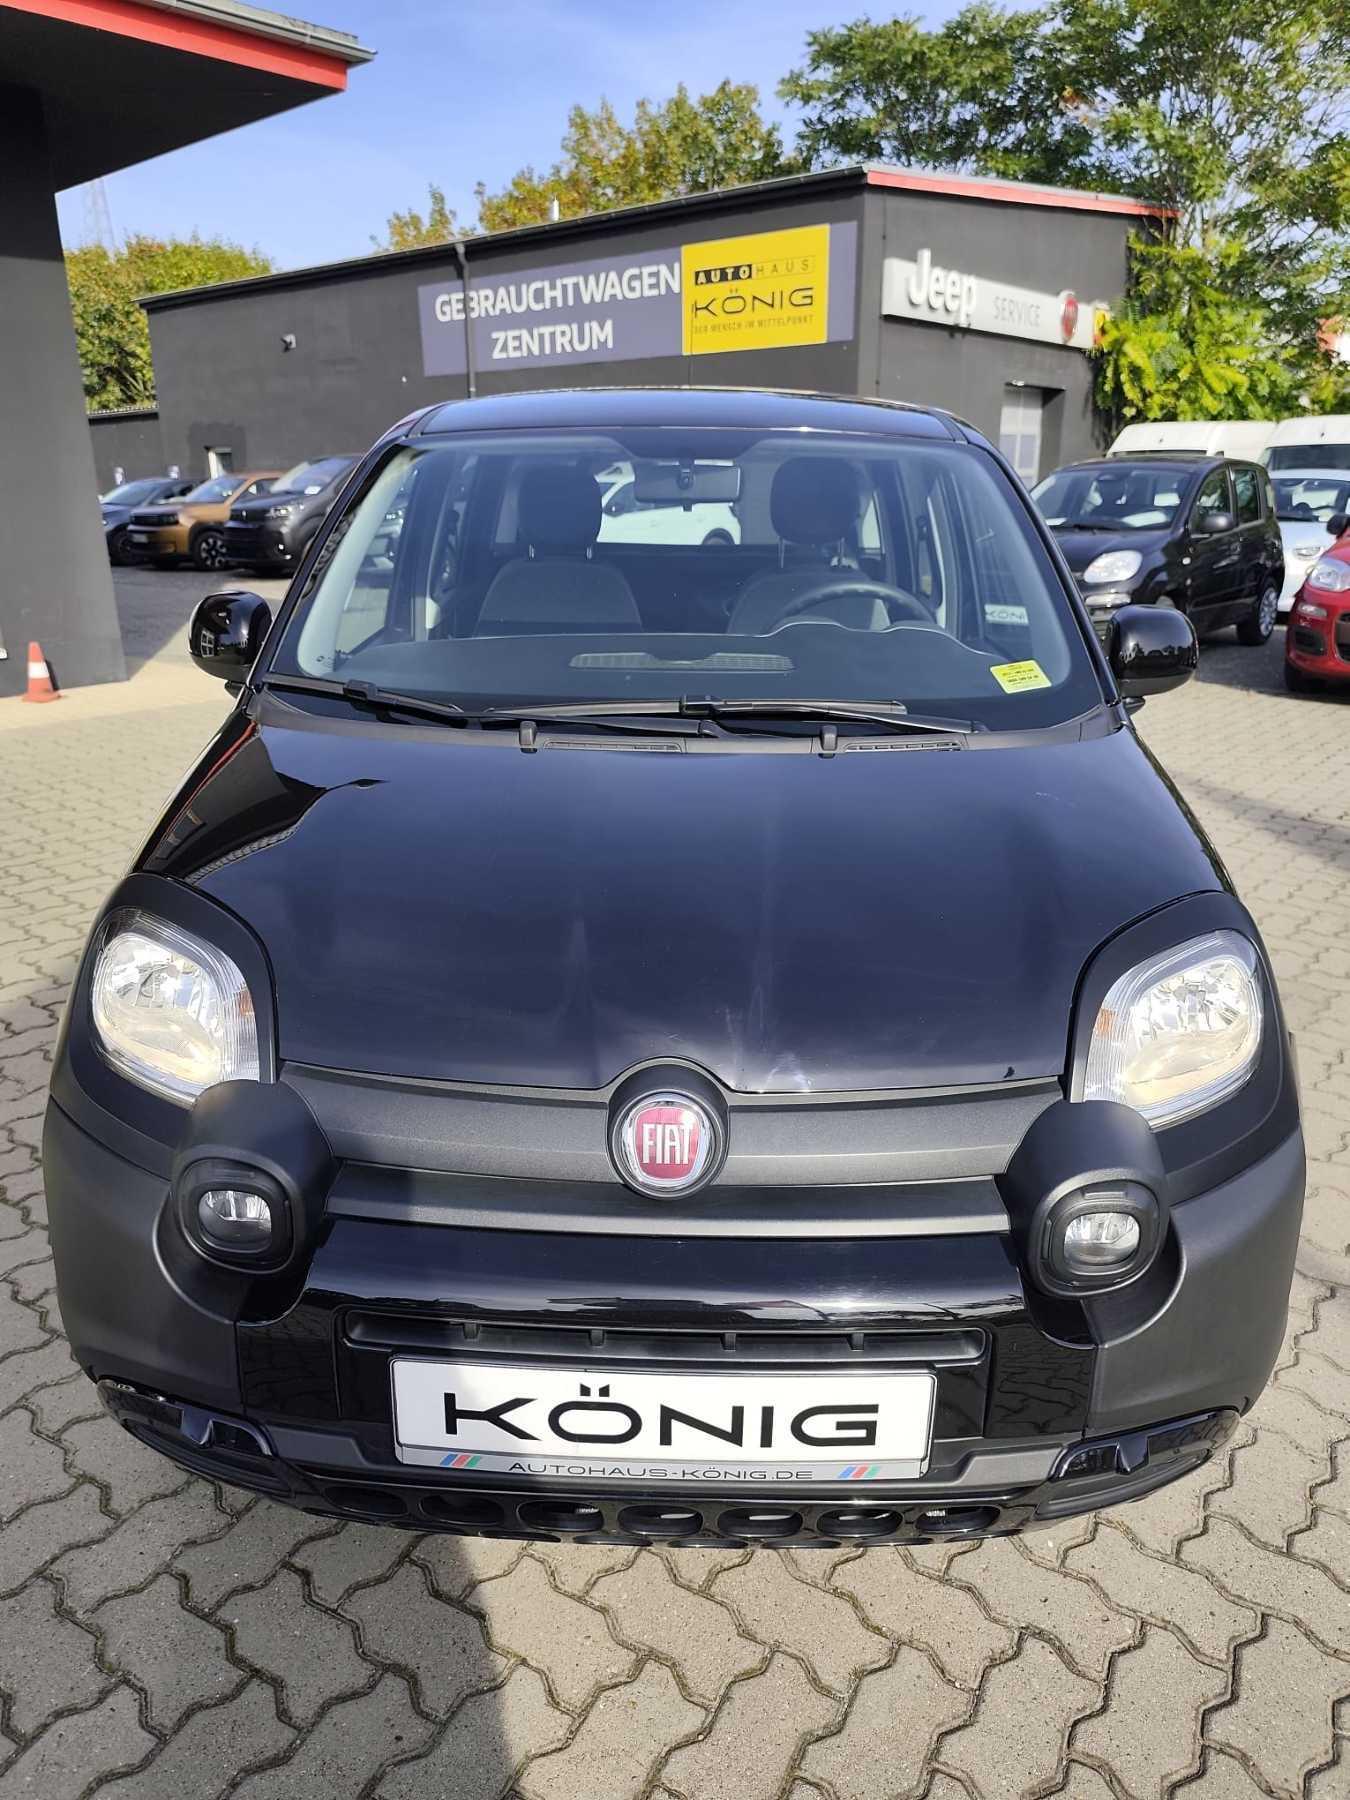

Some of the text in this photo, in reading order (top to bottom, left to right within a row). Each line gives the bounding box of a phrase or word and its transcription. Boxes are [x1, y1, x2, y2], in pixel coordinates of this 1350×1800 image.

[435, 261, 681, 322] GEBRAUCHTWAGEN
[694, 287, 814, 318] KÖNIG
[908, 248, 977, 328] Jeep
[993, 295, 1041, 328] SERVICE
[491, 319, 614, 359] ZENTRUM
[642, 1122, 694, 1165] FIAT
[443, 1383, 880, 1449] KÖNIG
[507, 1461, 814, 1480] AUTOHAUS-KÖNIG.DE
